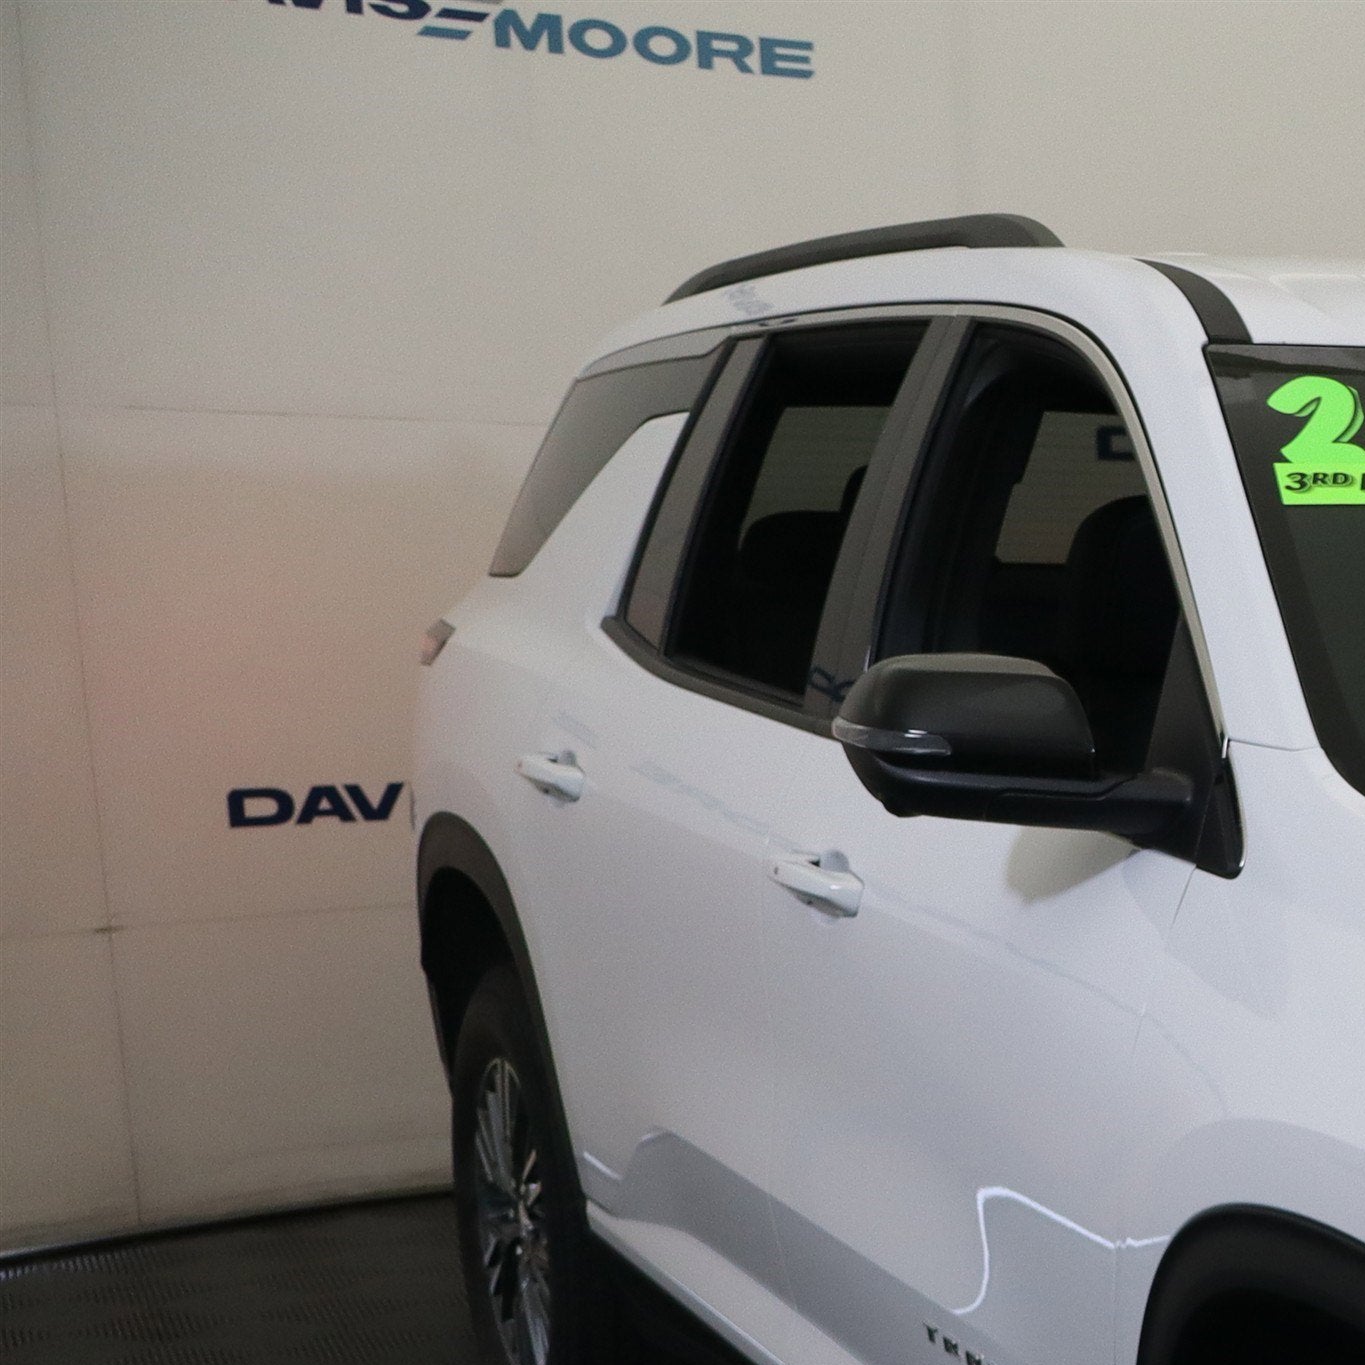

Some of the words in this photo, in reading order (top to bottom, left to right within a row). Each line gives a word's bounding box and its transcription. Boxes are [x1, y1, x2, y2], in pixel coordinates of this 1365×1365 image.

[494, 8, 815, 80] MOORE
[1284, 472, 1354, 493] 3RD
[227, 782, 405, 829] DAV
